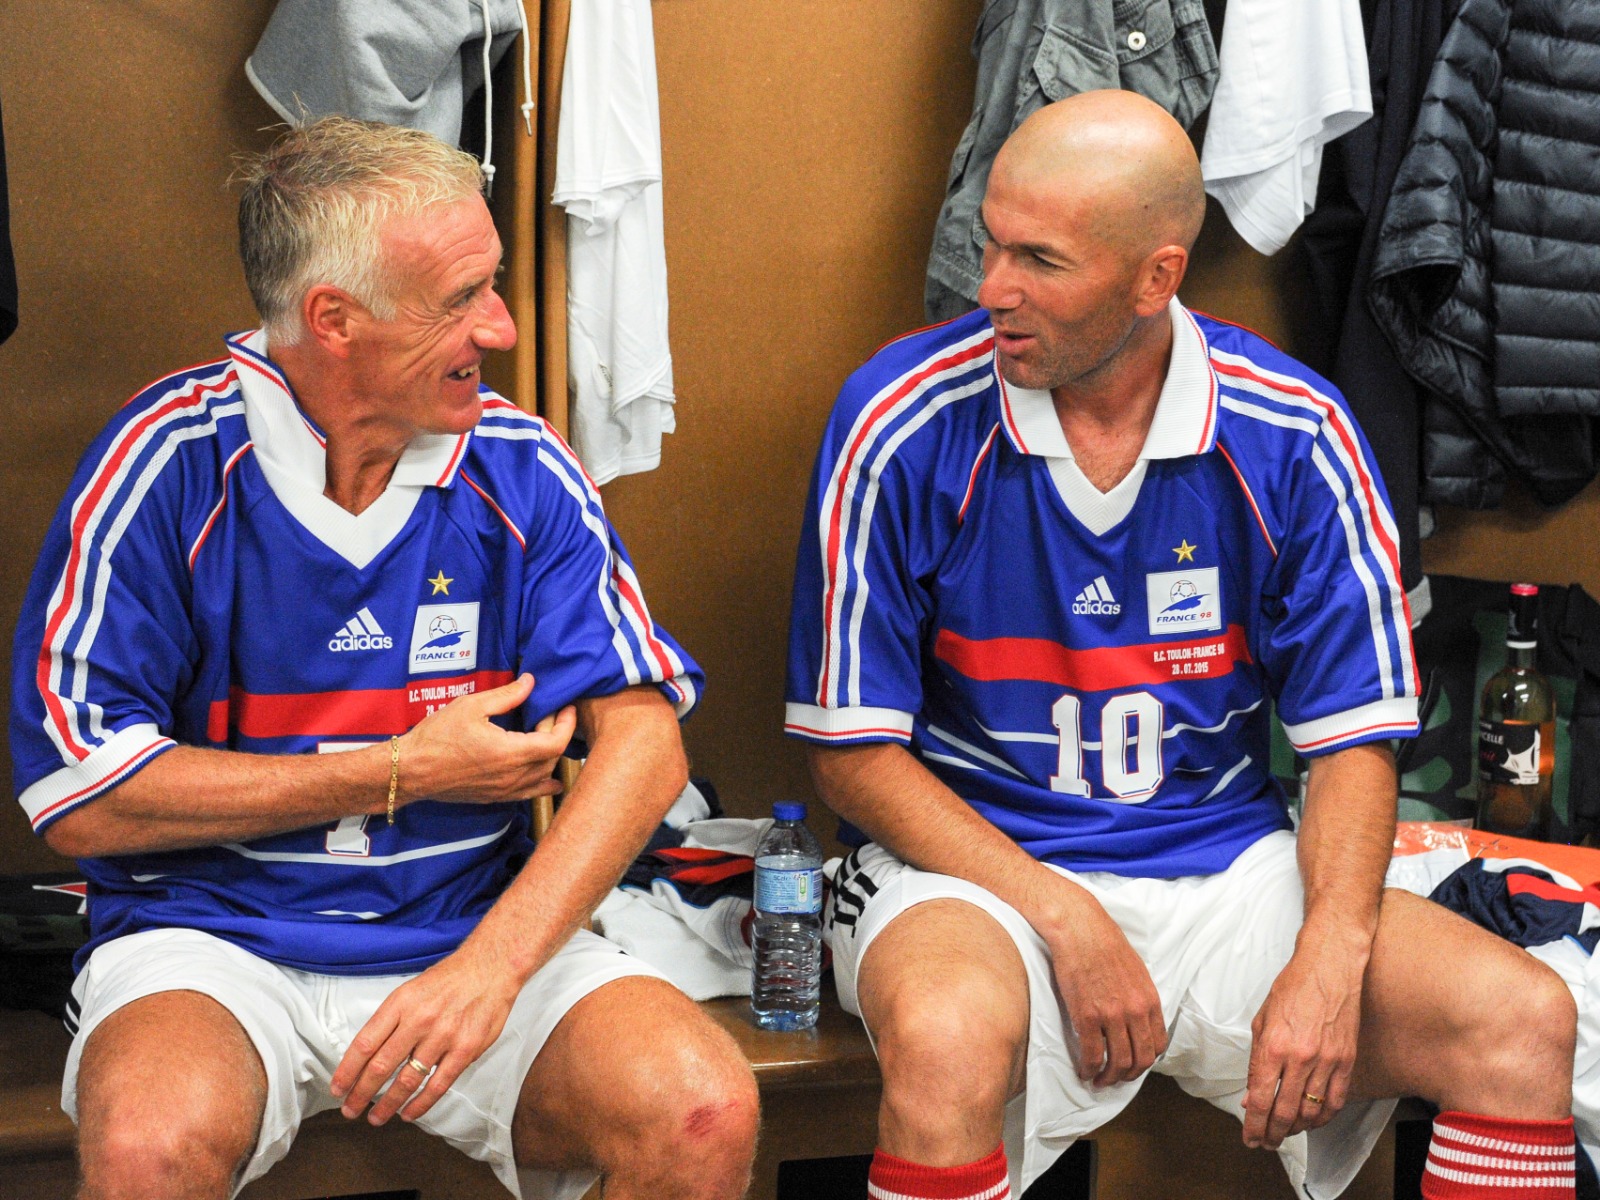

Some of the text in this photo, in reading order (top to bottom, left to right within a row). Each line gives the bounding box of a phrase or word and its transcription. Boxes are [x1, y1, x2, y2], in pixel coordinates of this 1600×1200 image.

[1072, 599, 1121, 615] adidas
[1156, 611, 1212, 623] FRANCE 98
[328, 634, 393, 652] adidas
[415, 650, 471, 661] FRANCE 98
[1153, 643, 1225, 662] R.C. TOULON-FRANCE 98
[420, 682, 469, 701] TOULON-FRANCE
[1050, 691, 1164, 799] 10
